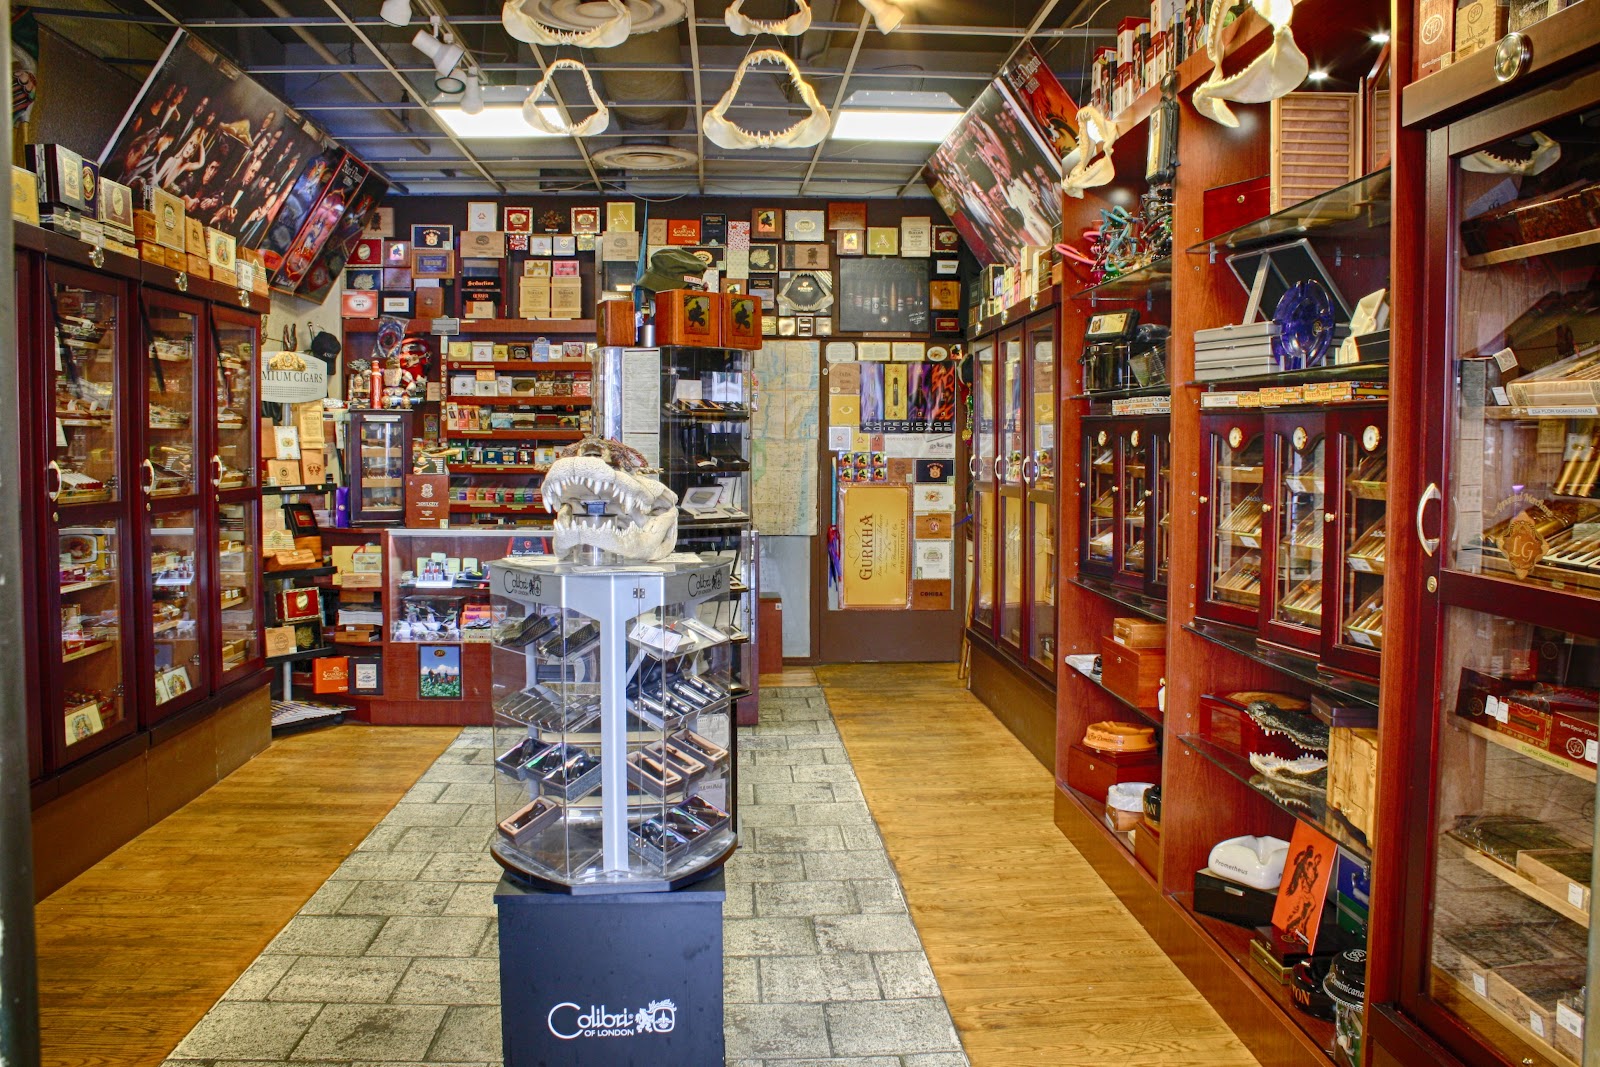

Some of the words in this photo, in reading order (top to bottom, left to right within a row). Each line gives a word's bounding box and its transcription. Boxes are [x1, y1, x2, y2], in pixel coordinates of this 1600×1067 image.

[293, 371, 323, 383] CIGARS
[1306, 391, 1330, 399] CUESTA-REY
[859, 513, 873, 581] GURKHA
[503, 570, 529, 594] Colibri
[688, 573, 711, 597] Colibri
[1215, 858, 1248, 876] Prometheus
[547, 1002, 634, 1040] Colibri
[584, 1029, 596, 1037] OF
[597, 1029, 634, 1037] LONDON
